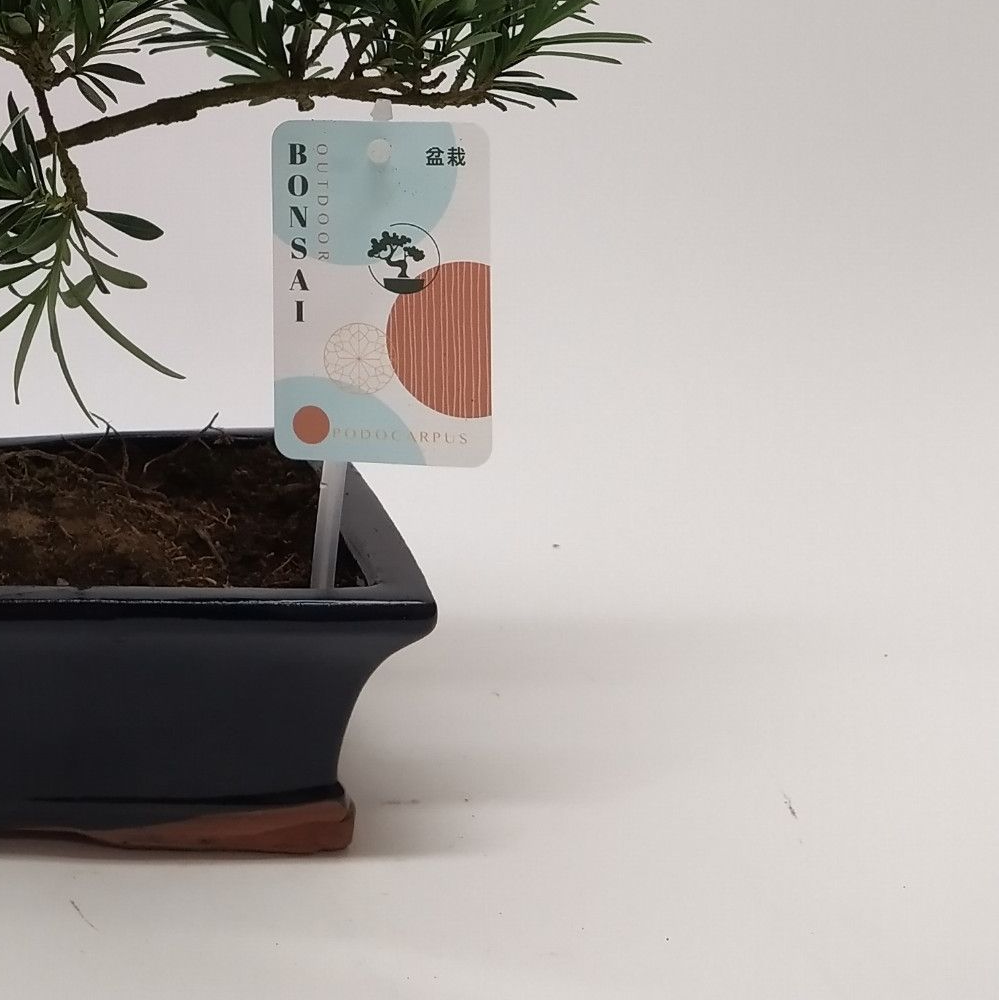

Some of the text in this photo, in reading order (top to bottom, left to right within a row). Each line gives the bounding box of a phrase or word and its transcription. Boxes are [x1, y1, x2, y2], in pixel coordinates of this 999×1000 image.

[425, 147, 466, 167] 盆栽
[287, 143, 309, 322] BONSAI
[316, 143, 330, 261] OUTDOOR
[332, 427, 468, 444] PODOCARPUS
